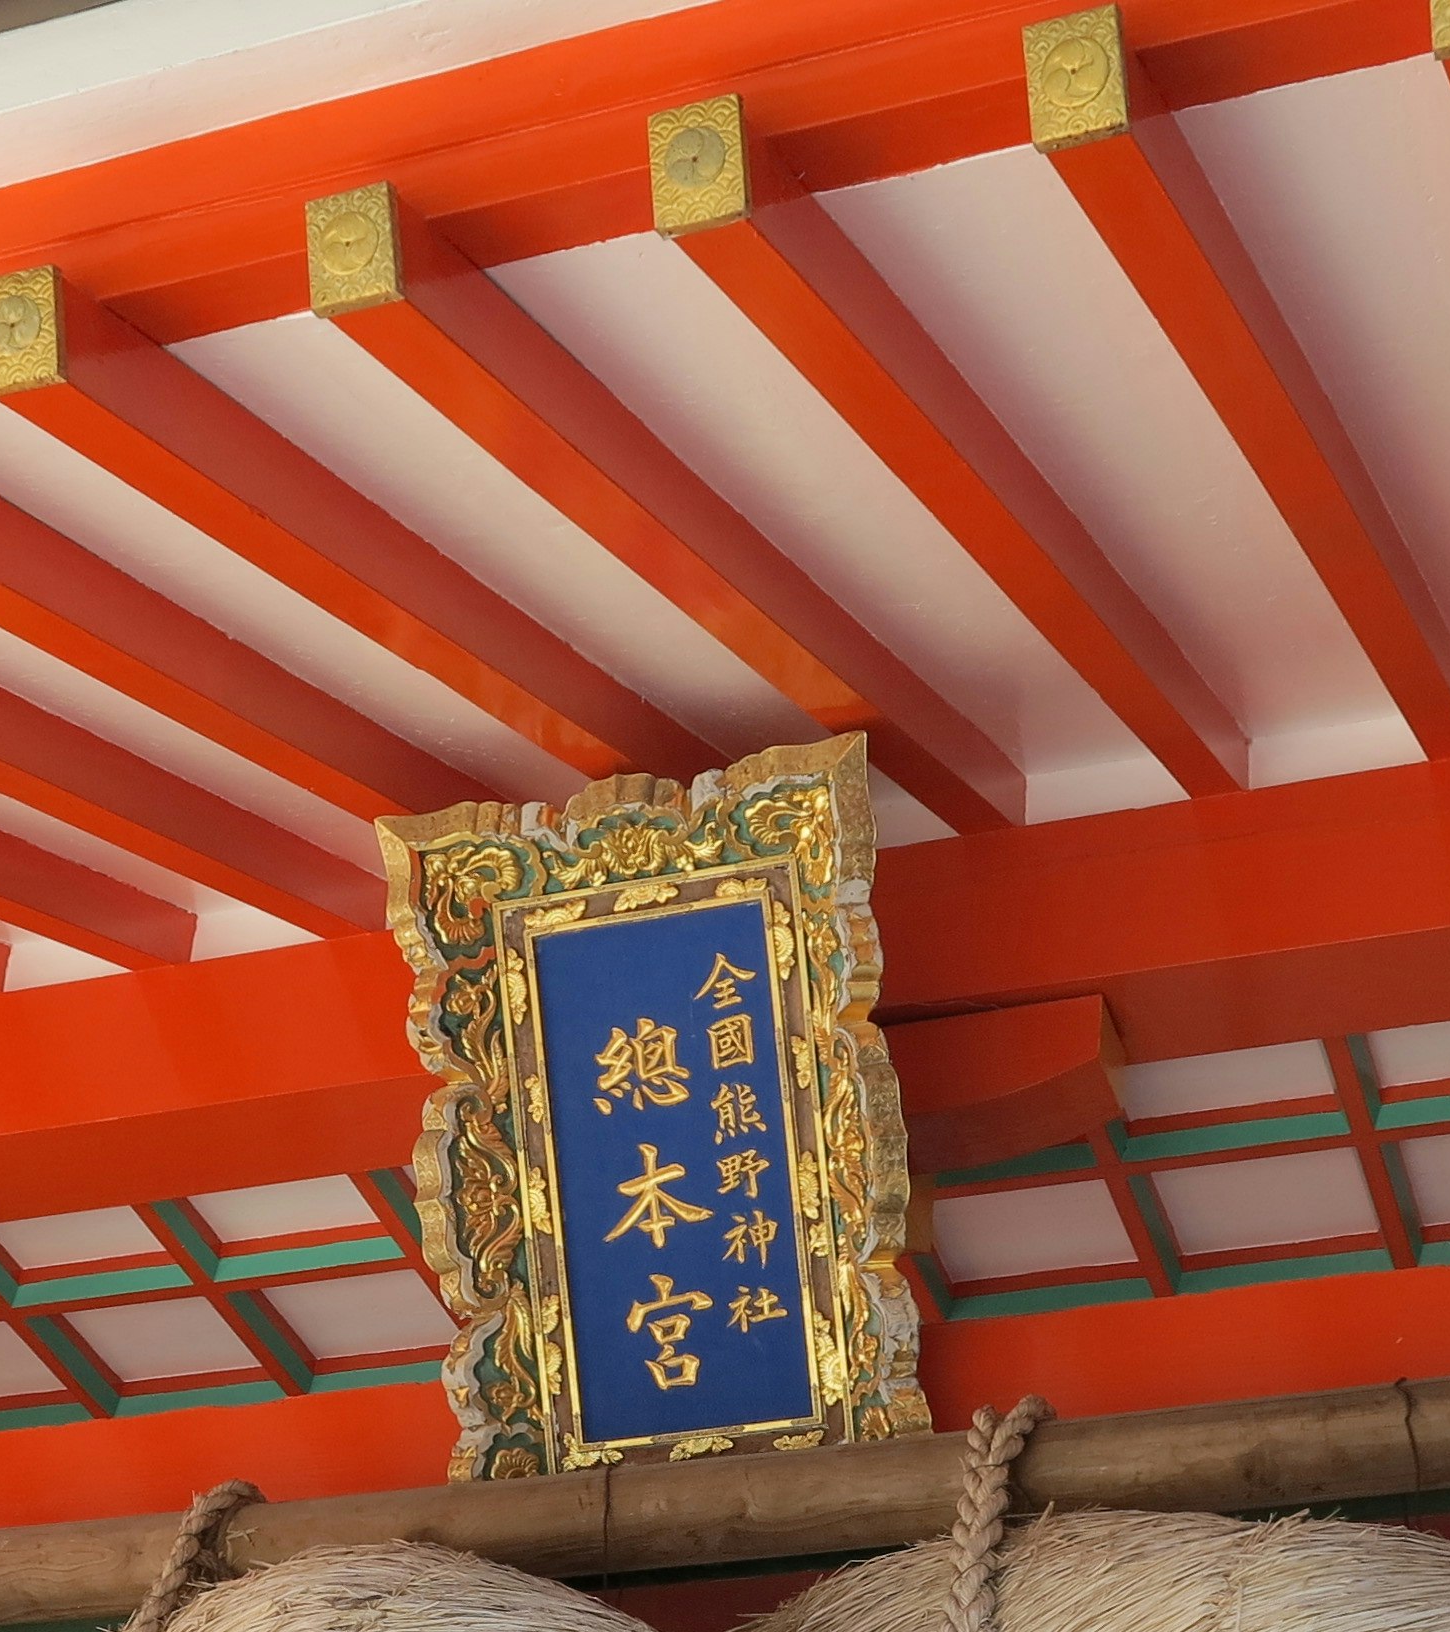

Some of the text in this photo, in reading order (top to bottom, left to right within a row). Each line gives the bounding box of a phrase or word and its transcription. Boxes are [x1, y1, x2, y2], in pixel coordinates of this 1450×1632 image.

[592, 1017, 714, 1392] 總本宮
[693, 951, 788, 1333] 全國熊野神社
